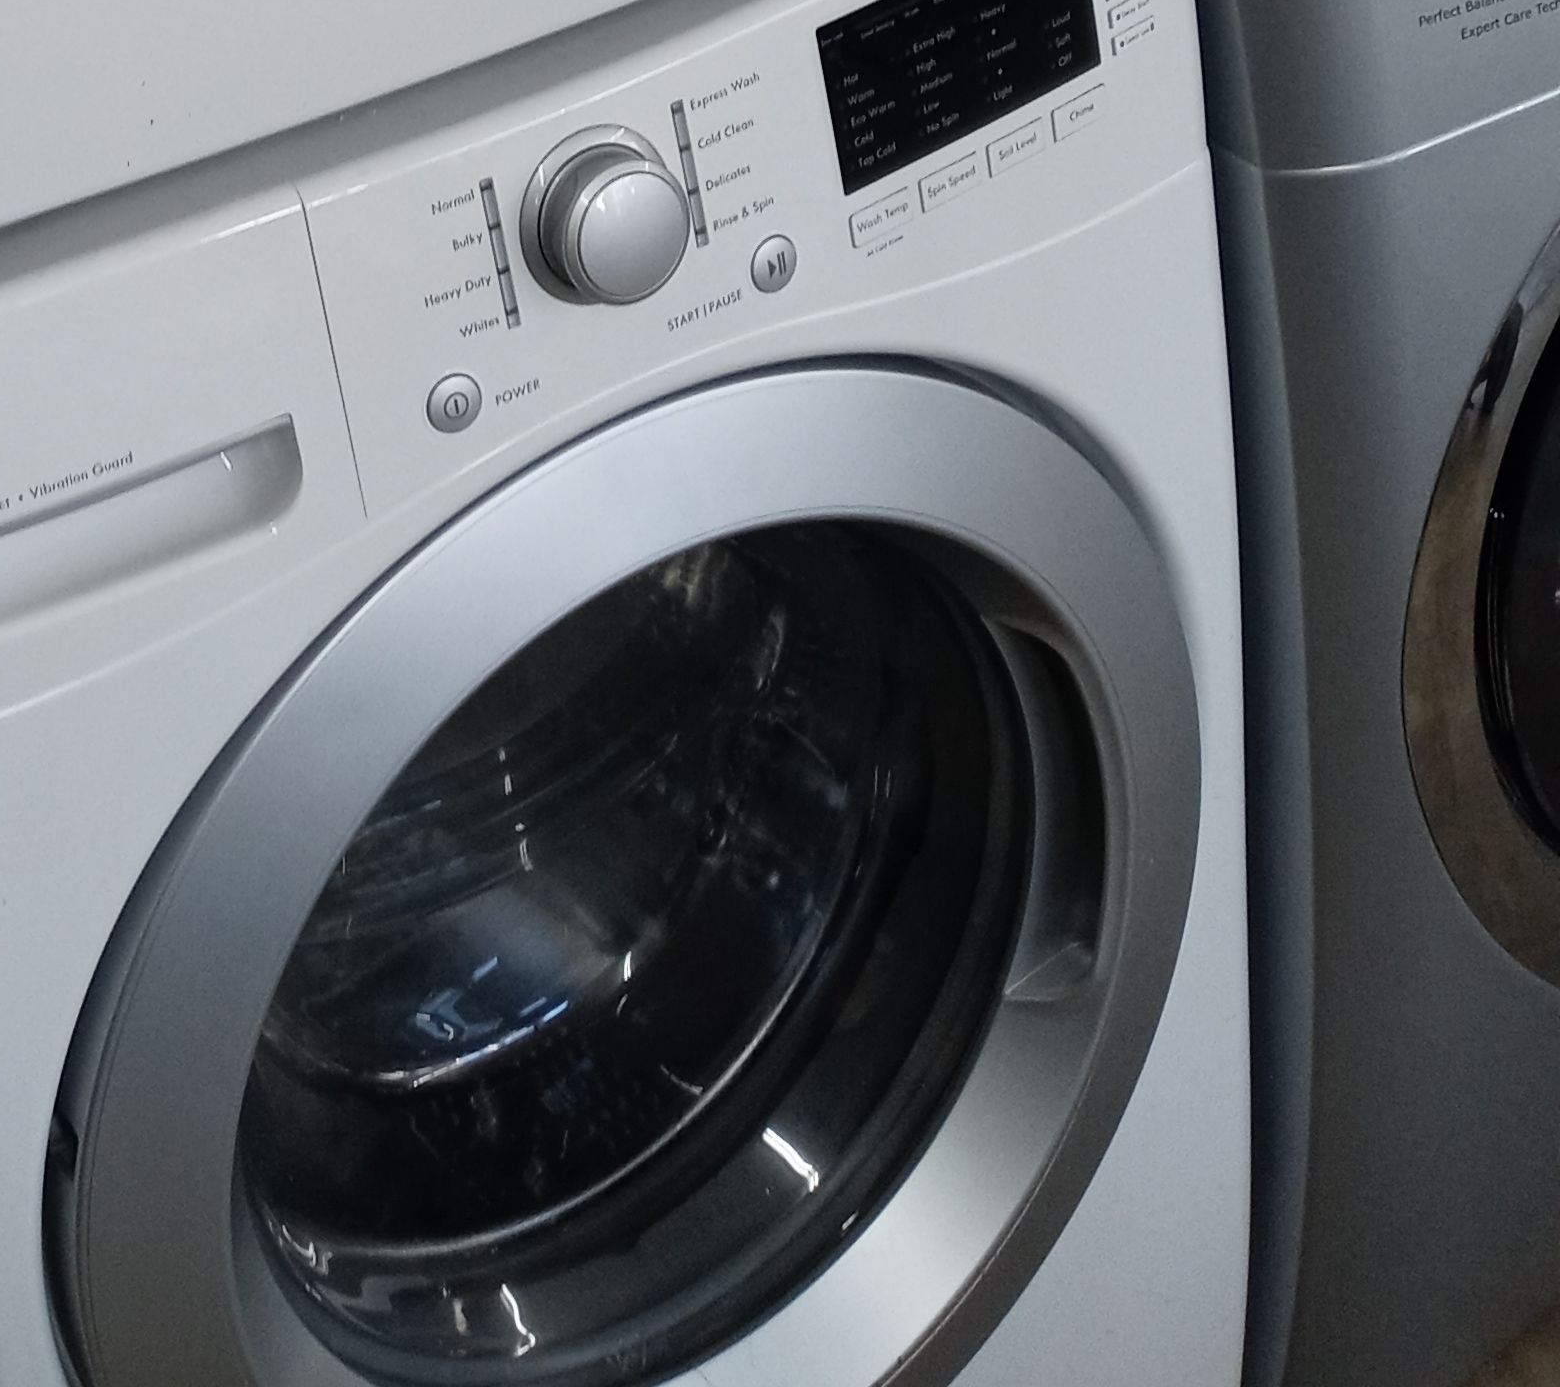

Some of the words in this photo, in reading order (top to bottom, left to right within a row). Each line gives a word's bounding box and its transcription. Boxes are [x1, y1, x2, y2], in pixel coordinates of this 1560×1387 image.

[1419, 5, 1462, 28] Perfect
[1461, 18, 1500, 40] Expert
[1504, 9, 1532, 25] Care
[986, 38, 1017, 61] Normal
[916, 56, 937, 76] High
[689, 87, 728, 111] Express
[730, 72, 760, 93] Wash
[920, 71, 953, 94] Medium
[993, 84, 1013, 103] Light
[848, 87, 875, 107] Warm
[868, 99, 896, 120] Warm
[1069, 102, 1095, 123] Chime
[697, 132, 722, 150] Cold
[725, 118, 754, 139] Clean
[854, 130, 874, 148] Cold
[998, 140, 1015, 162] Soil
[1016, 132, 1037, 153] Level
[877, 141, 897, 160] Cold
[705, 164, 752, 191] Delicates
[928, 179, 945, 200] Spin
[948, 164, 976, 187] Speed
[431, 189, 475, 215] Normal
[713, 213, 740, 231] Rinse
[753, 195, 774, 215] Spin
[856, 213, 882, 233] Wash
[885, 203, 909, 219] Temp
[452, 232, 484, 252] Bulky
[424, 286, 462, 308] Heavy
[464, 274, 492, 294] Duty
[667, 309, 700, 332] START
[709, 289, 744, 315] PAUSE
[460, 316, 500, 338] Whites
[495, 378, 541, 407] POWER
[29, 470, 89, 501] Vibration
[92, 450, 134, 476] Guard
